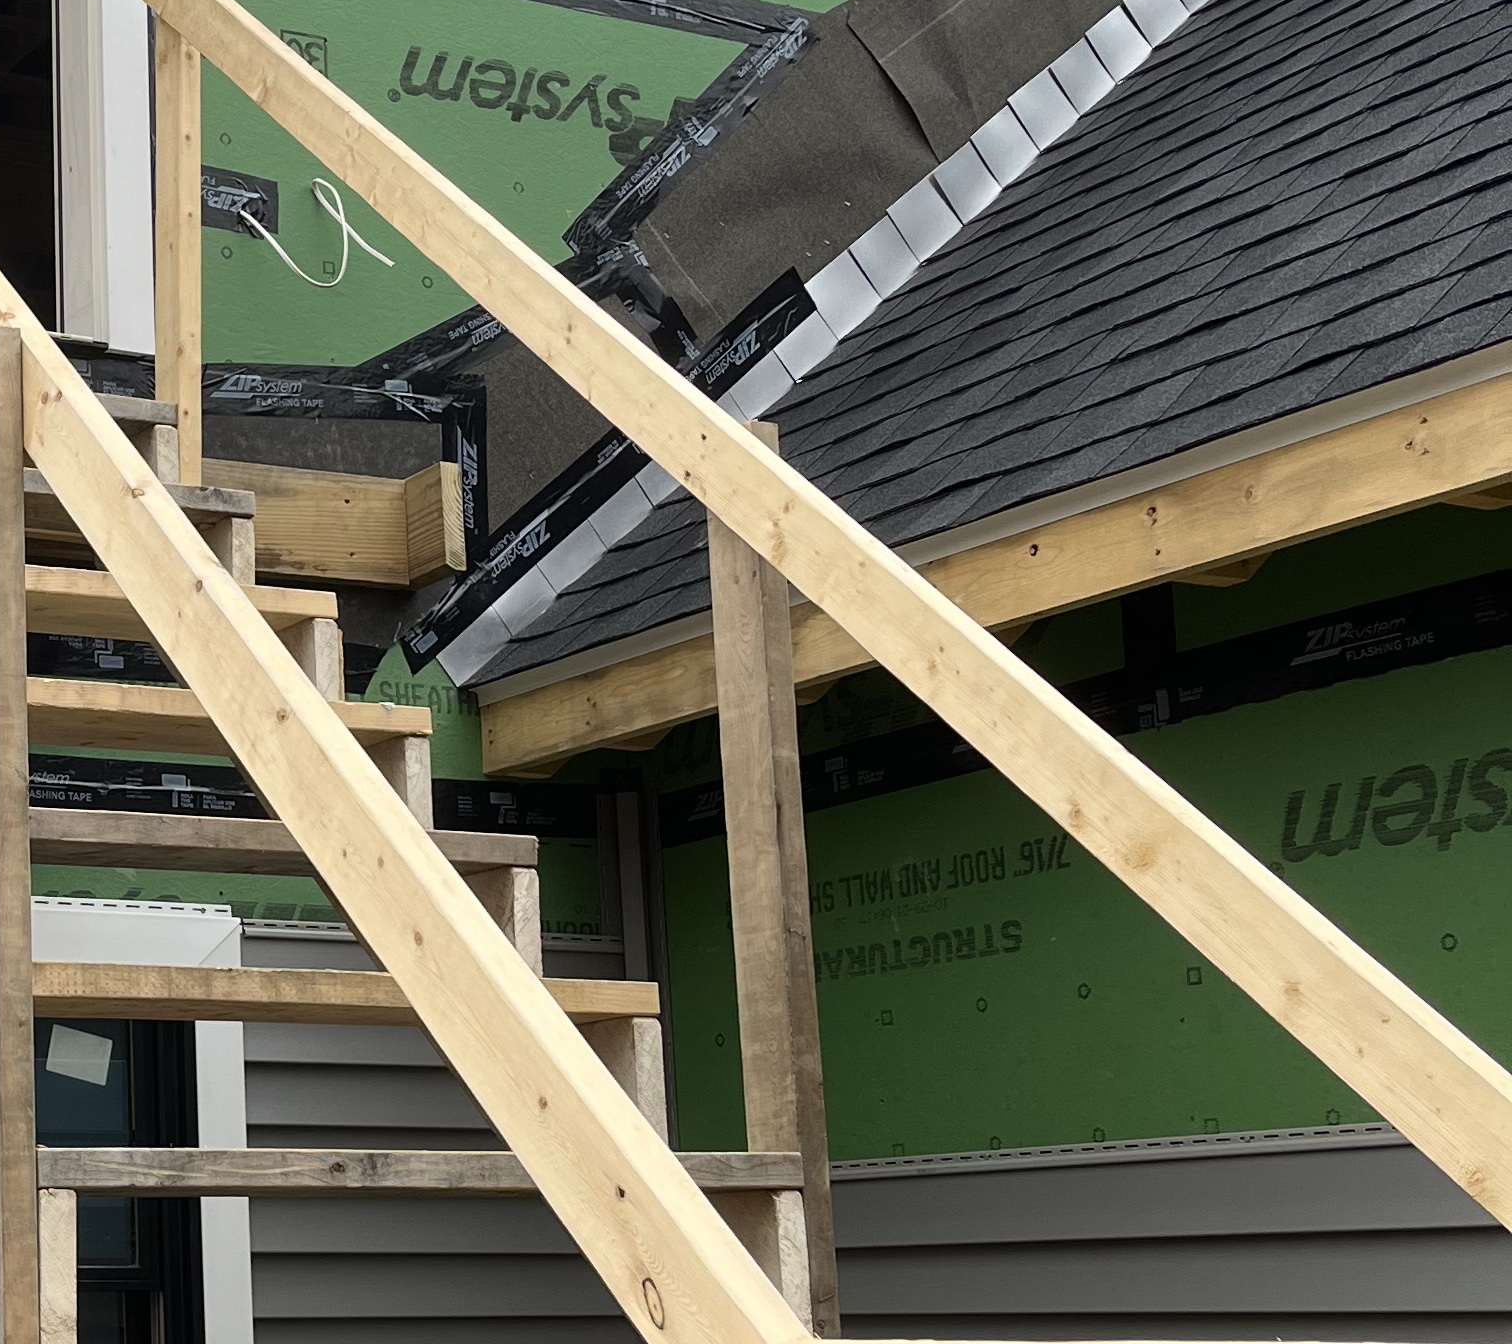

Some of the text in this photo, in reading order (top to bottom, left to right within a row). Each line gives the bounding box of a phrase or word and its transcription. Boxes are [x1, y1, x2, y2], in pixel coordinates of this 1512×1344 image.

[629, 152, 661, 184] FLASHING
[699, 337, 731, 370] FLASHING
[704, 329, 762, 385] ZIPsystem
[221, 374, 304, 395] ZIPsystem
[255, 397, 325, 409] FLASHING TAPE
[462, 437, 479, 530] ZIPsystem
[490, 519, 552, 578] ZIPsystem
[1303, 615, 1408, 654] ZIPsystem
[1345, 631, 1436, 663] FLASHING TAPE
[28, 789, 93, 803] ASHING TAPE
[839, 866, 897, 909] WALL
[899, 857, 943, 900] AND
[952, 844, 1008, 891] ROOF
[814, 918, 1024, 985] STRUCTURA
